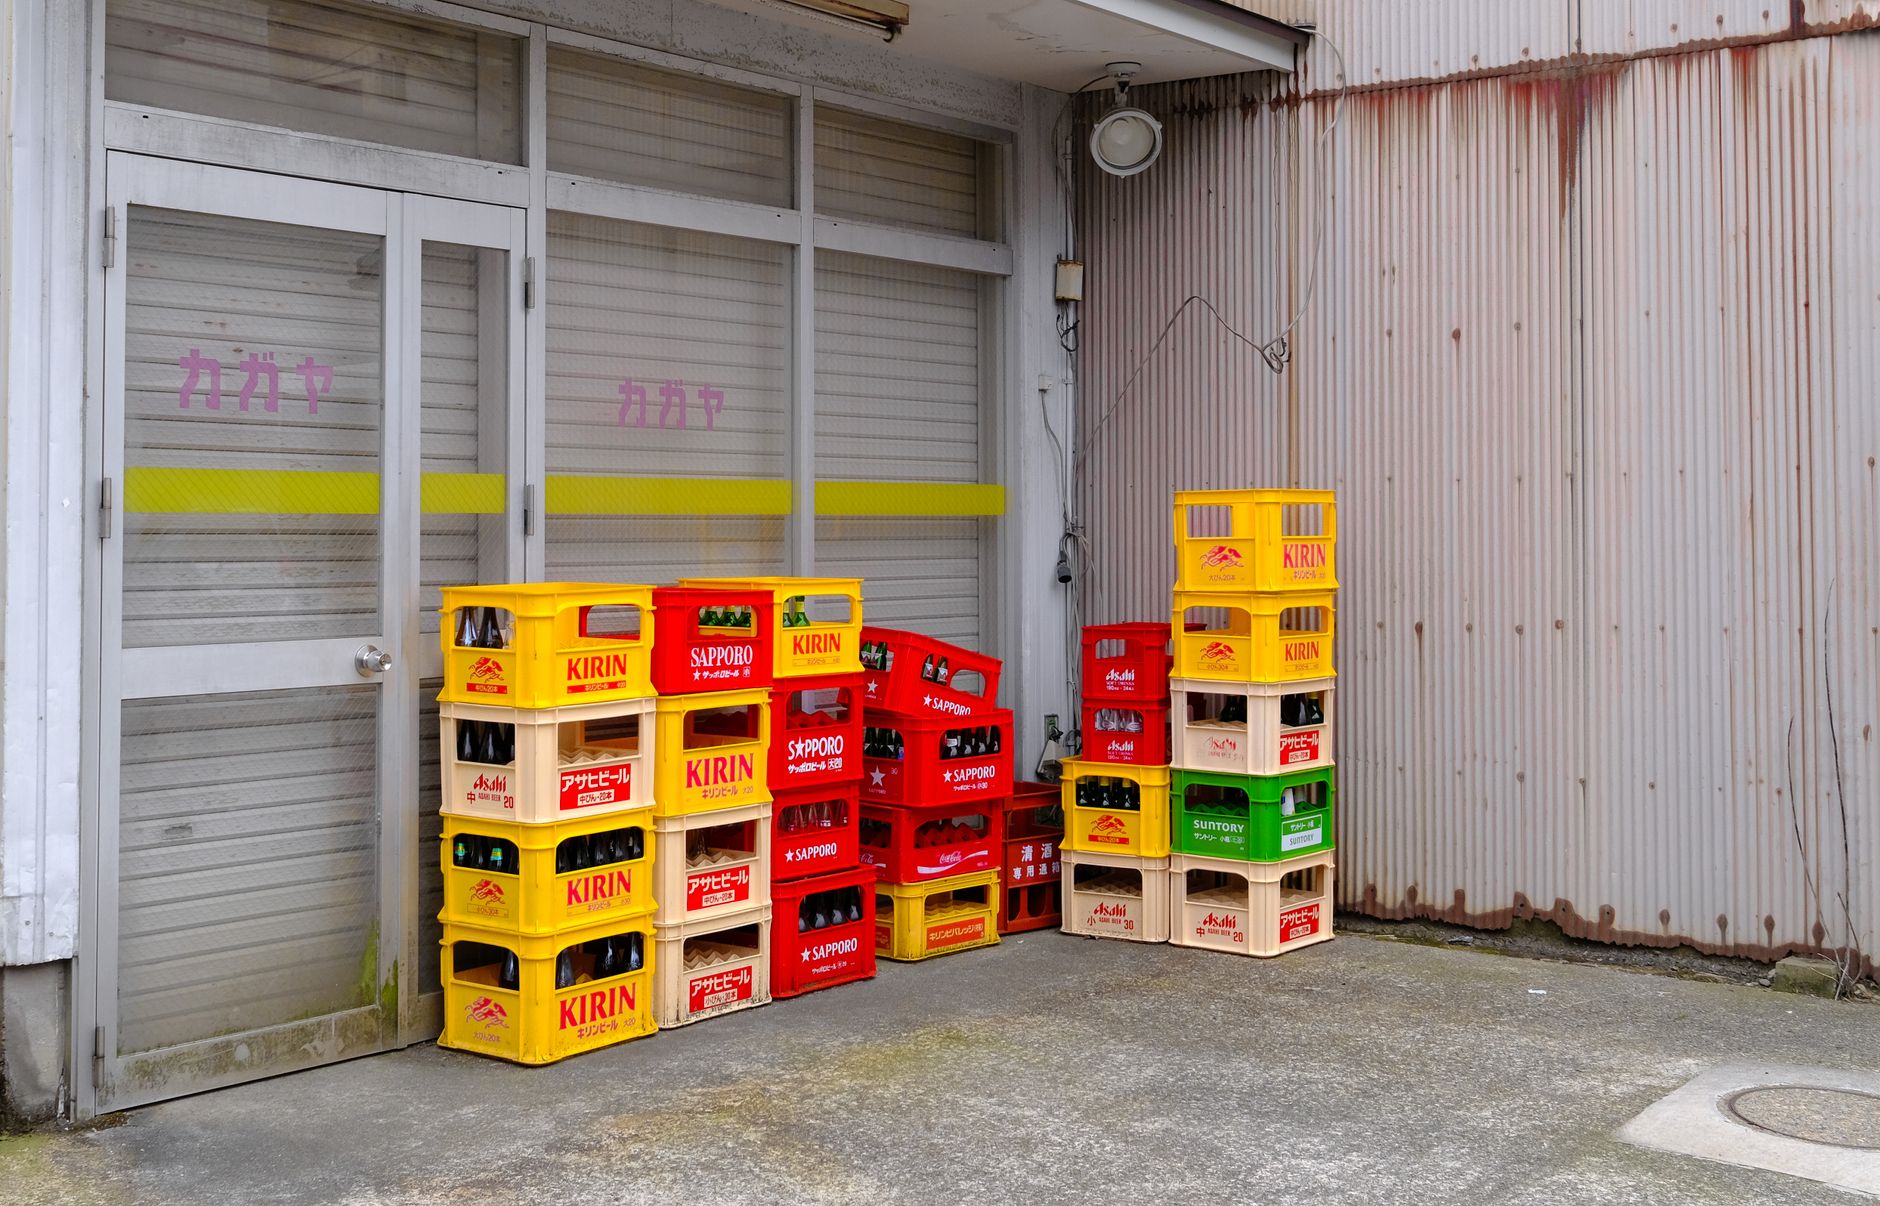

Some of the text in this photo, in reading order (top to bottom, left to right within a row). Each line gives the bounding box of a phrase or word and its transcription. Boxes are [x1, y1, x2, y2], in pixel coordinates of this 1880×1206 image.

[179, 348, 334, 415] カガヤ
[618, 377, 724, 430] カガヤ
[1283, 543, 1326, 569] KIRIN
[793, 633, 841, 655] KIRIN
[1285, 641, 1320, 662] KIRIN
[690, 645, 753, 667] SAPPORO
[567, 654, 628, 681] KIRIN
[702, 669, 740, 679] サッポロビール
[1105, 668, 1135, 681] Asahi
[932, 697, 971, 716] SAPPORO
[1107, 739, 1134, 751] Asahi
[1280, 733, 1319, 751] アサヒビール
[686, 753, 754, 788] KIRIN
[788, 761, 827, 774] サッポロビール
[953, 765, 995, 782] SAPPORO
[473, 773, 507, 793] Asahi
[561, 768, 630, 792] アサヒビール
[467, 791, 476, 804] 中
[503, 795, 514, 809] 20
[702, 785, 739, 800] キリンビール
[1194, 832, 1217, 841] サントリー
[795, 842, 837, 861] SAPPORO
[939, 850, 962, 864] Coca-Cola
[567, 869, 632, 906] KIRIN
[689, 869, 749, 894] アサヒビール
[1094, 902, 1126, 917] Asahi
[1280, 906, 1319, 929] アサヒビール
[1087, 915, 1096, 926] 小
[1124, 919, 1134, 930] 30
[1203, 912, 1236, 929] Asahi
[1196, 926, 1205, 937] 中
[1233, 931, 1244, 942] 20
[812, 938, 858, 961] SAPPORO
[691, 969, 750, 997] アサヒビール
[559, 982, 636, 1030] KIRIN
[577, 1019, 619, 1040] キリンビール
